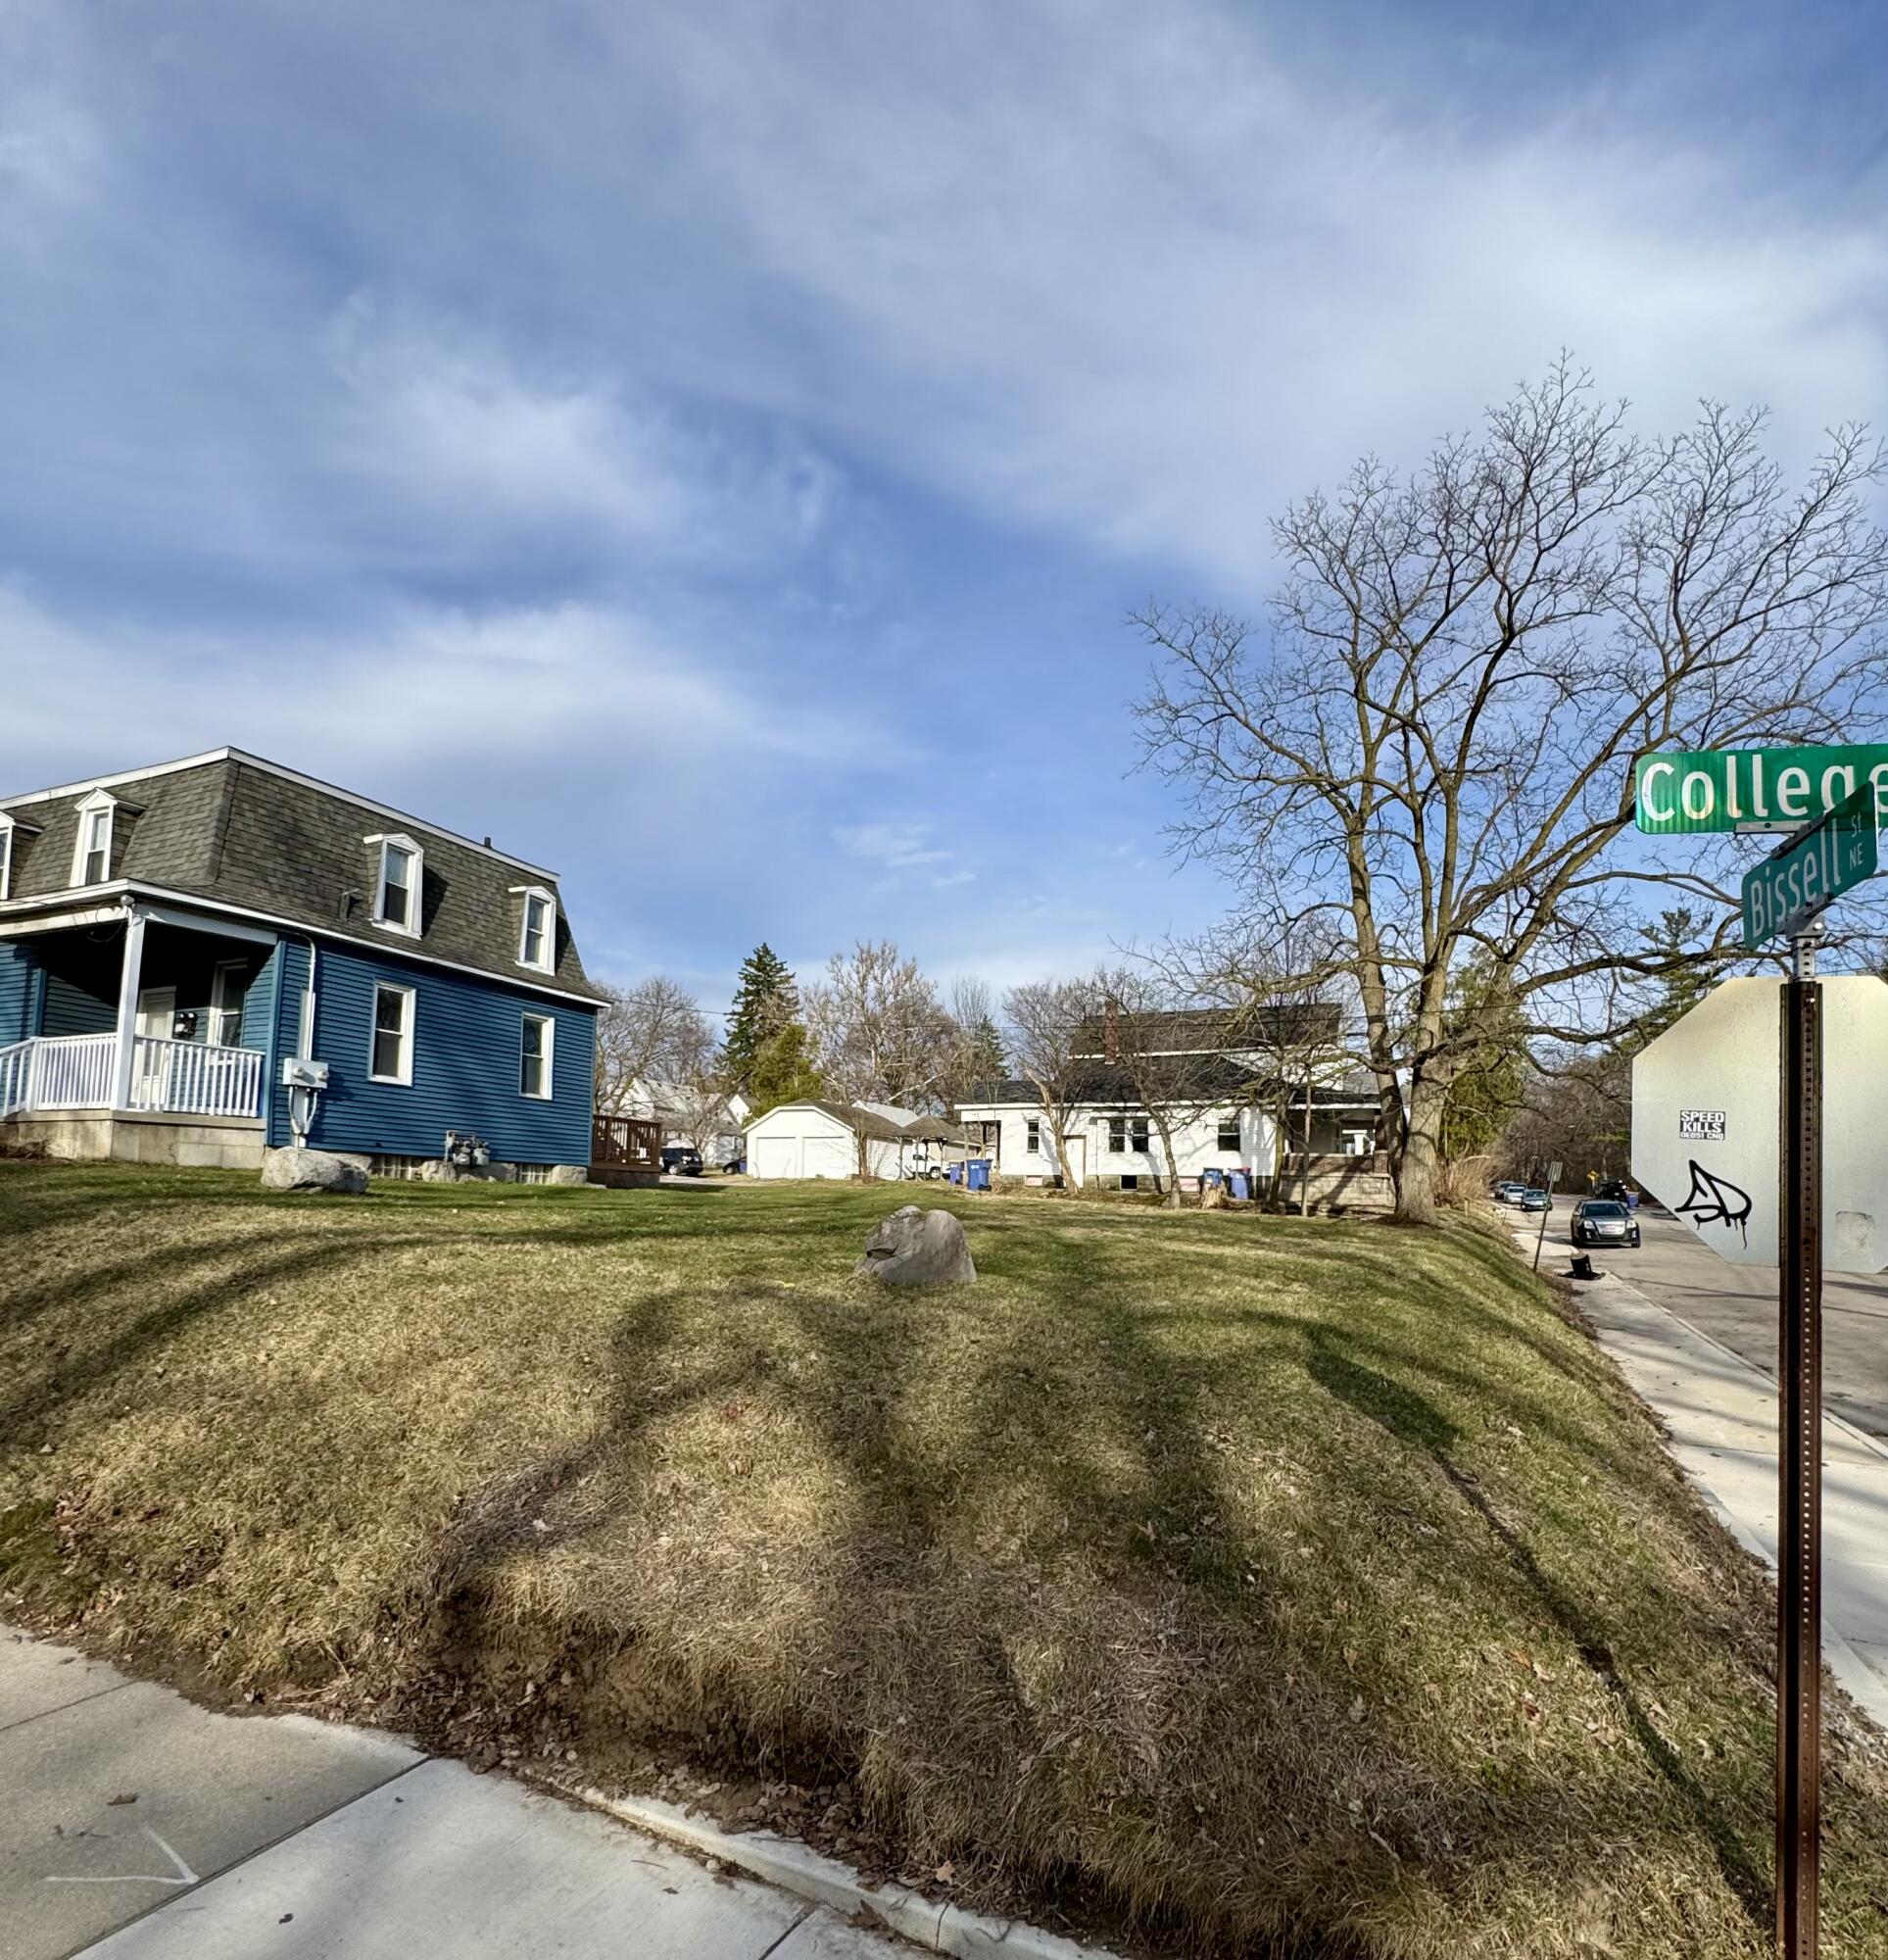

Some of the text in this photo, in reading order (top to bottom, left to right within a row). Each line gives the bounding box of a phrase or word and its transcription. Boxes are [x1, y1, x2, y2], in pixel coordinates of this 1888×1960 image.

[1851, 811, 1863, 838] St
[1850, 842, 1864, 870] NE
[1751, 818, 1840, 939] Bissell
[1680, 1110, 1724, 1123] SPEED
[1682, 1121, 1722, 1133] KILLS
